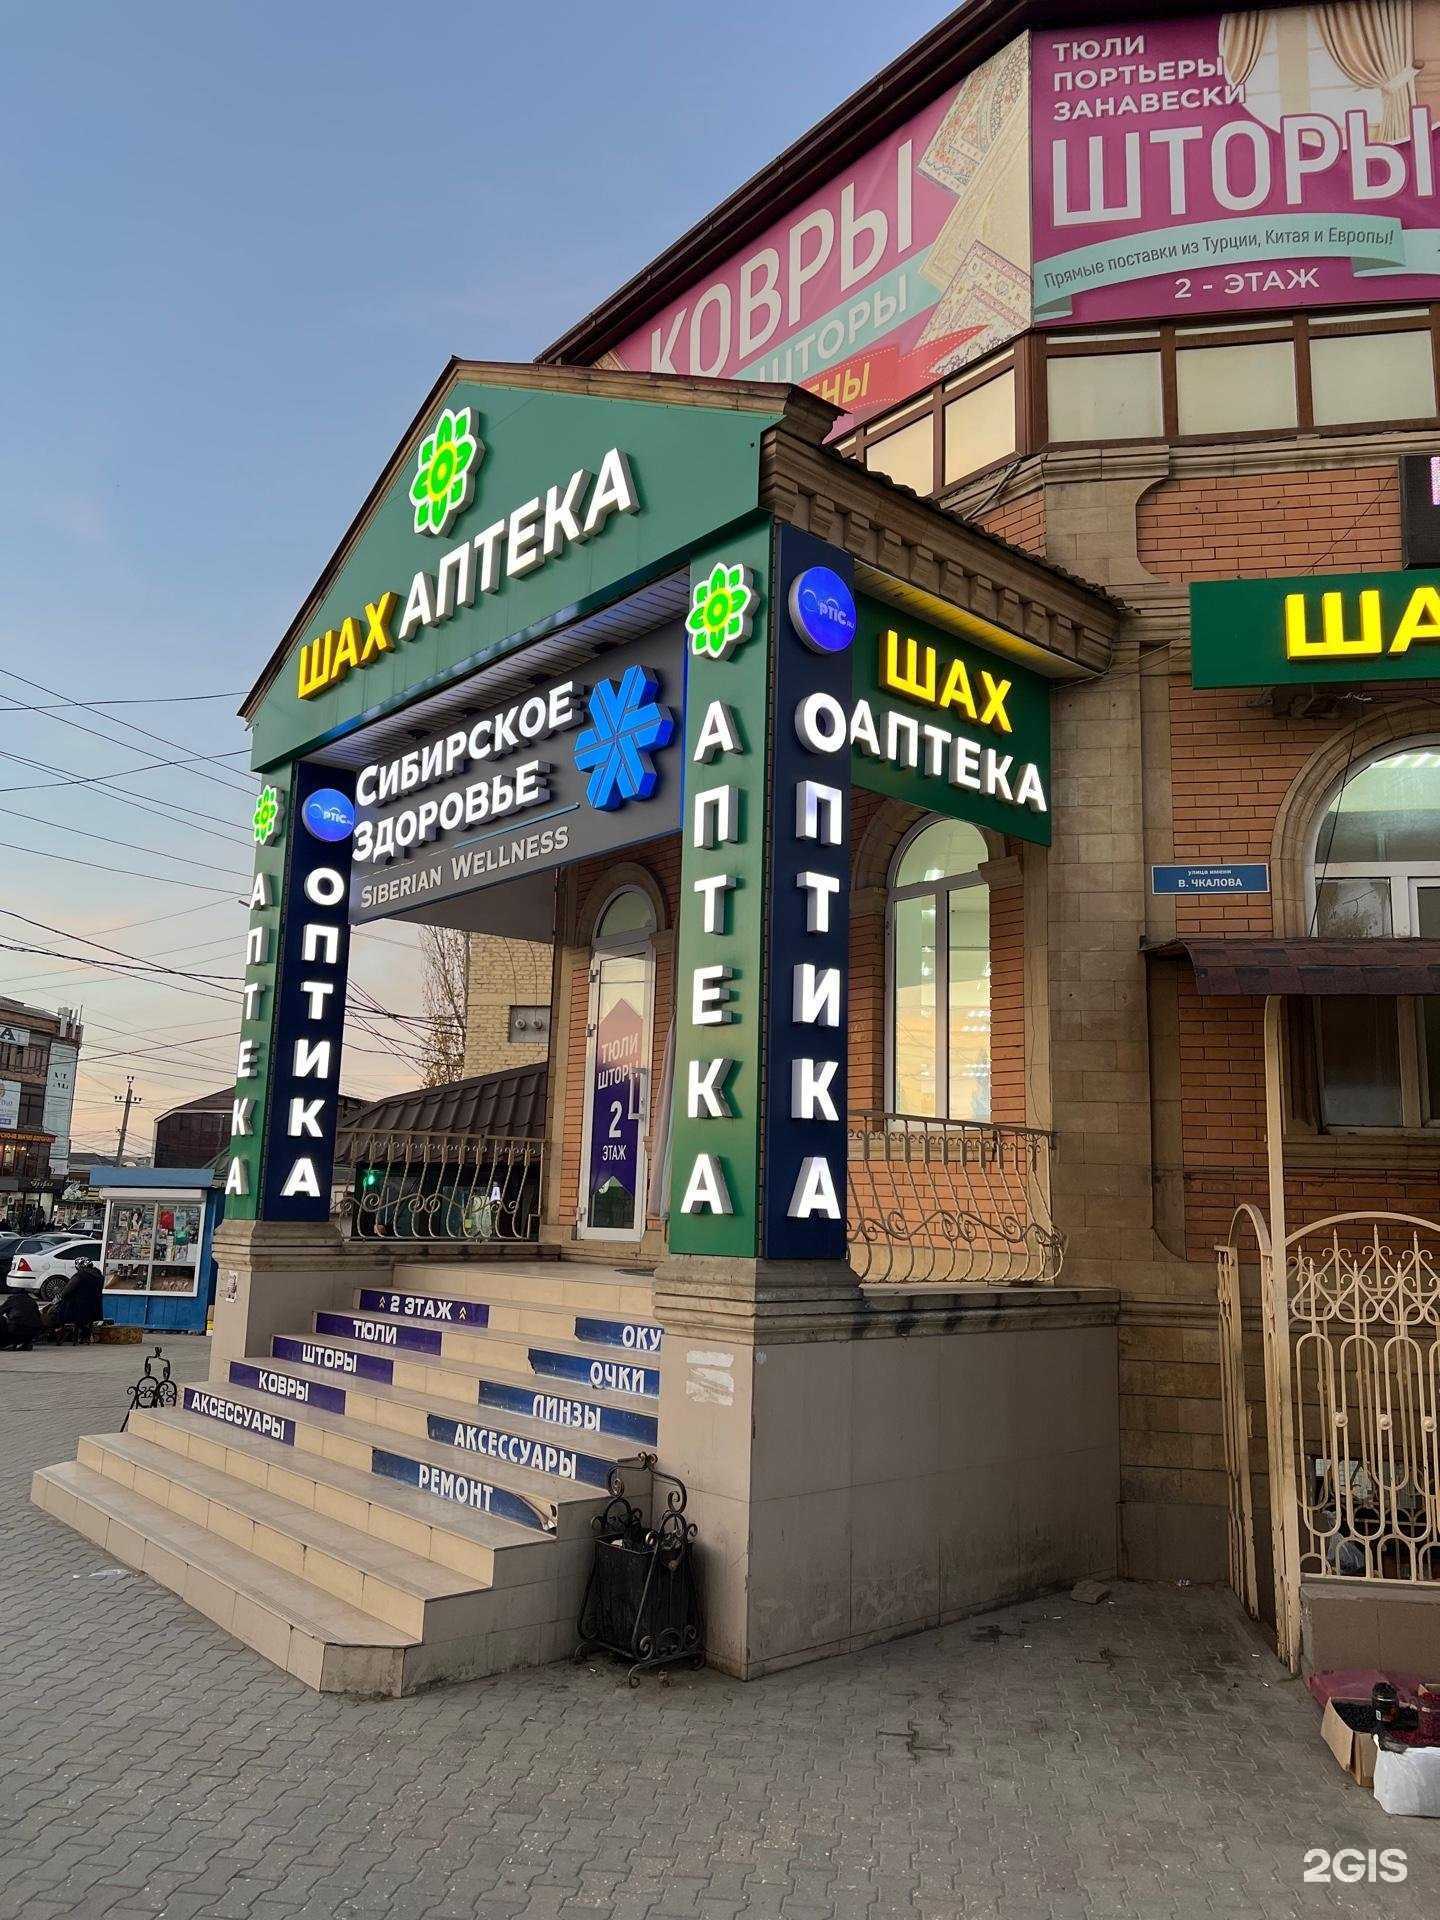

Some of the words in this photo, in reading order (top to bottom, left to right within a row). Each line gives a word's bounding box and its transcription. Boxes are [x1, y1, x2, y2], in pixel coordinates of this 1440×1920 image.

[1052, 35, 1145, 62] ТЮЛИ
[1053, 57, 1224, 92] ПОРТЬЕРЫ
[1052, 84, 1247, 121] ЗАНАВЕСКИ
[1052, 106, 1434, 227] ШТОРЫ
[650, 139, 913, 377] КОВРЫ
[1044, 260, 1104, 289] Прямые
[1108, 244, 1178, 273] поставки
[1181, 241, 1199, 255] из
[1203, 233, 1261, 257] Турции,
[1265, 228, 1309, 245] Китая
[1315, 231, 1324, 243] и
[1328, 227, 1394, 246] Европы!
[1174, 277, 1193, 300] 2
[1223, 267, 1321, 295] ЭТАЖ
[808, 361, 870, 406] НЫ
[298, 591, 397, 700] ШАХ
[398, 447, 640, 642] АПТЕКА
[881, 629, 1013, 733] ШАХ
[355, 680, 578, 808] СИБИРСКОЕ
[849, 699, 1048, 812] АПТЕКА
[351, 759, 547, 866] ЗДОРОВЬЕ
[360, 865, 443, 909] SIBERIAN
[450, 825, 570, 881] WELLNESS
[1178, 879, 1189, 887] В.
[1191, 878, 1243, 887] ЧКАЛОВА
[680, 700, 743, 1217] АПТЕКА
[788, 692, 846, 1219] ОПТИКА
[225, 871, 272, 1196] АПТЕКА
[279, 866, 345, 1197] ОПТИКА
[601, 1032, 639, 1064] ТЮЛИ
[608, 1100, 623, 1138] 2
[602, 1144, 627, 1161] ЭТАЖ
[389, 1295, 401, 1312] 2
[404, 1297, 453, 1319] ЭТАЖ
[352, 1319, 397, 1345] ТЮЛИ
[302, 1343, 357, 1373] ШТОРЫ
[589, 1361, 645, 1393] ОЧКИ
[258, 1370, 309, 1401] КОВРЫ
[190, 1392, 285, 1440] АКСЕССУАРЫ
[532, 1394, 601, 1432] ЛИНЗЫ
[453, 1423, 577, 1480] АКСЕССУАРЫ
[418, 1464, 494, 1512] РЕМОНТ
